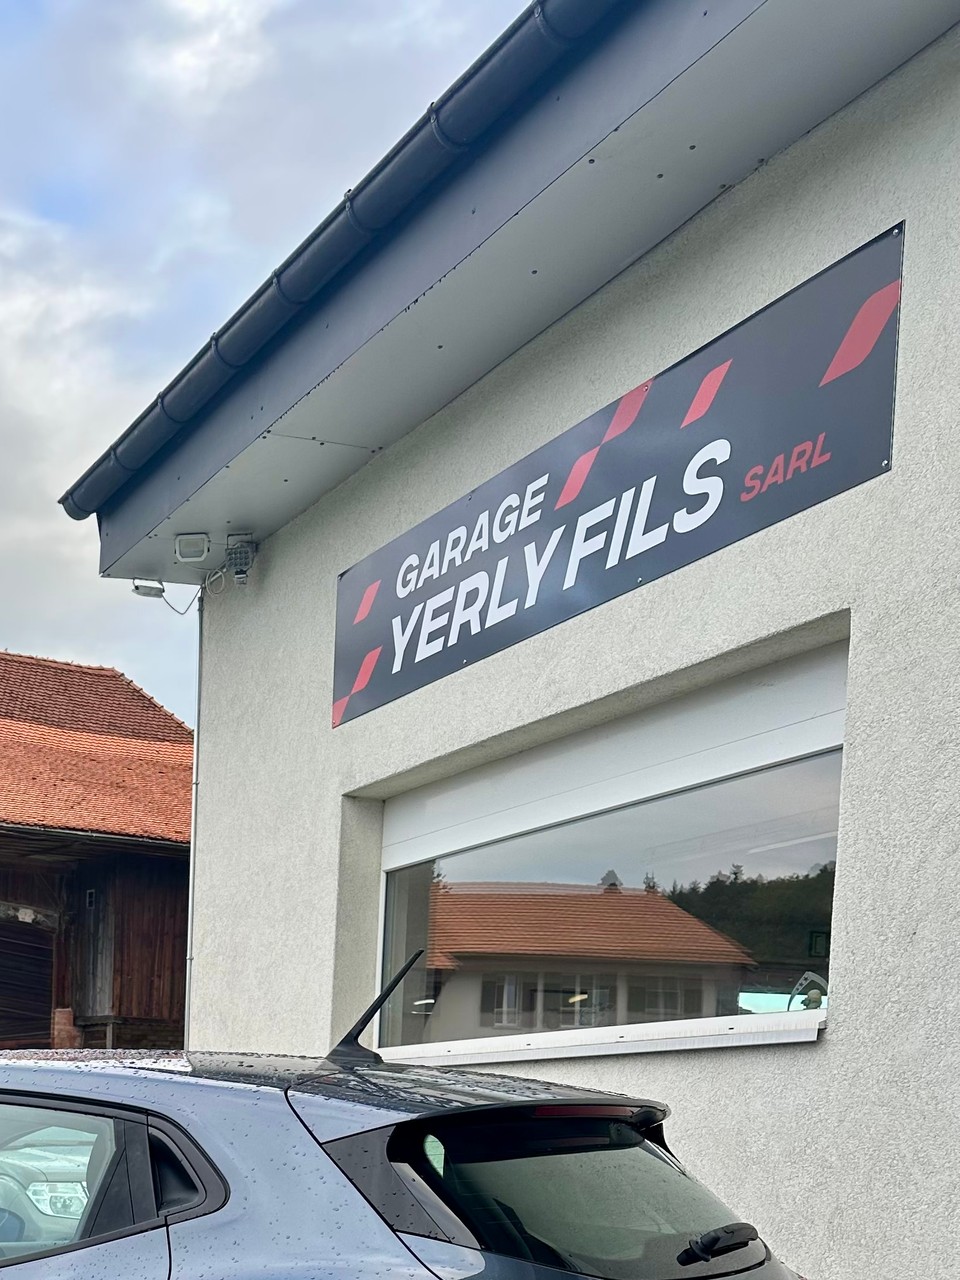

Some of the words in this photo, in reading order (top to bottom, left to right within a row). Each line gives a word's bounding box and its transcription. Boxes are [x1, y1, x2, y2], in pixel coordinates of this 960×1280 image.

[741, 432, 832, 502] SARL
[391, 524, 566, 674] YERLY
[562, 438, 732, 591] FILS
[396, 473, 549, 599] GARAGE
